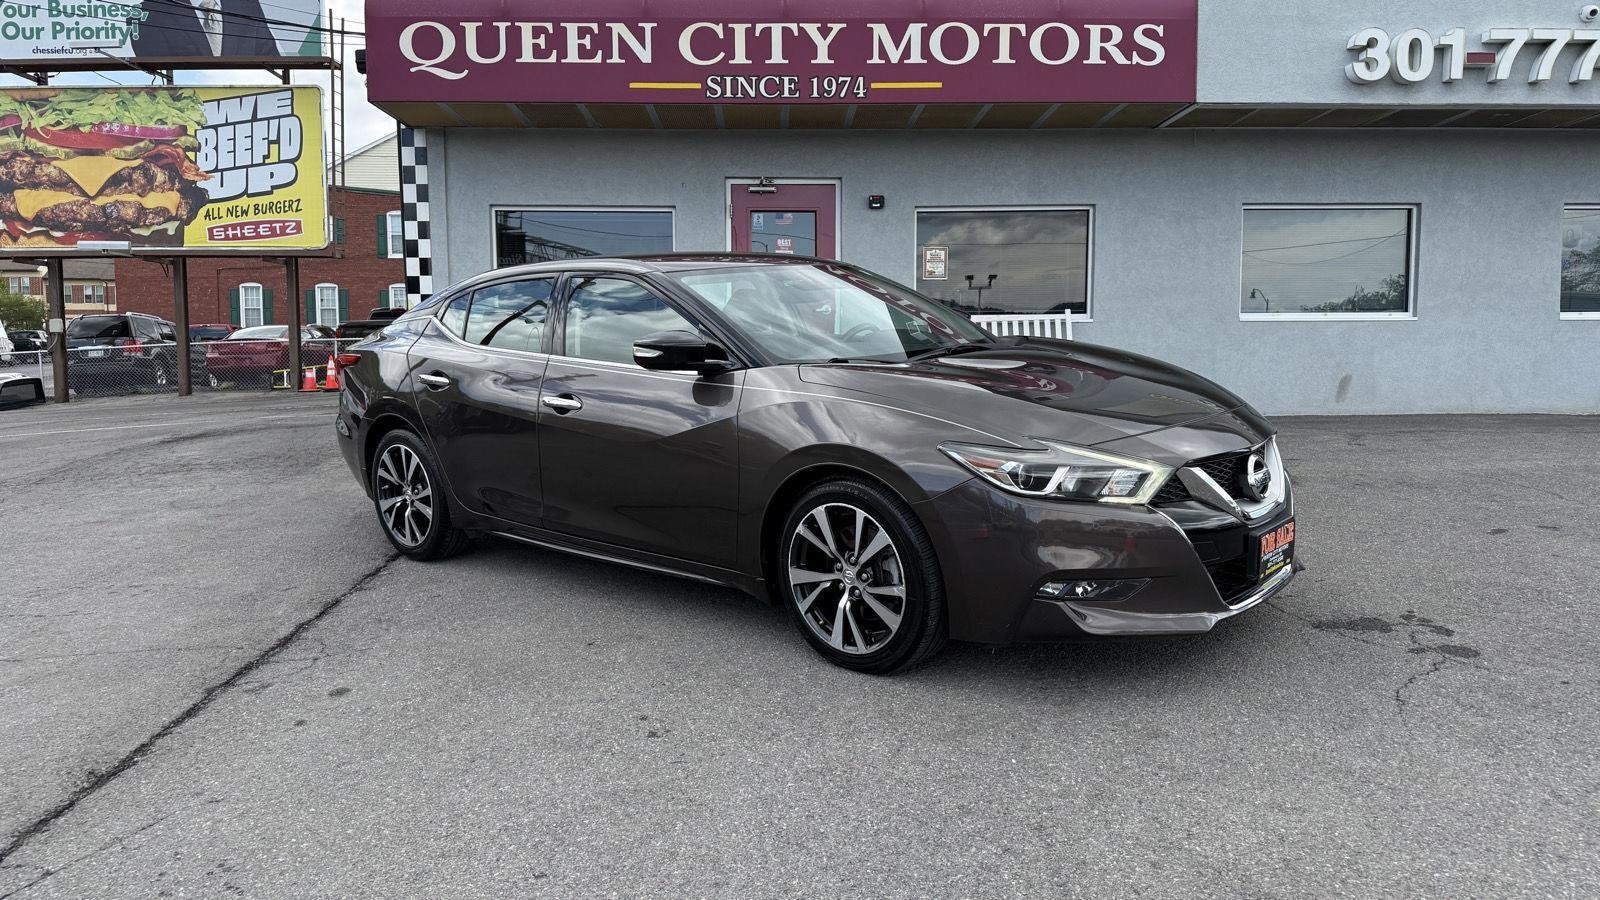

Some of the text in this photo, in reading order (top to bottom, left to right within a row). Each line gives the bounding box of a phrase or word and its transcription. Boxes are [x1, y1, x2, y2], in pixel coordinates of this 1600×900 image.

[0, 0, 149, 21] our Business,
[1, 20, 139, 46] Our Priority!
[399, 21, 1166, 80] QUEEN CITY MOTORS
[706, 75, 867, 98] SINCE 1974
[202, 90, 293, 126] WE
[196, 116, 302, 173] BEEF'D
[199, 163, 297, 200] UP
[204, 199, 302, 221] ALL NEW BURGERZ
[213, 222, 297, 239] SHEETZ
